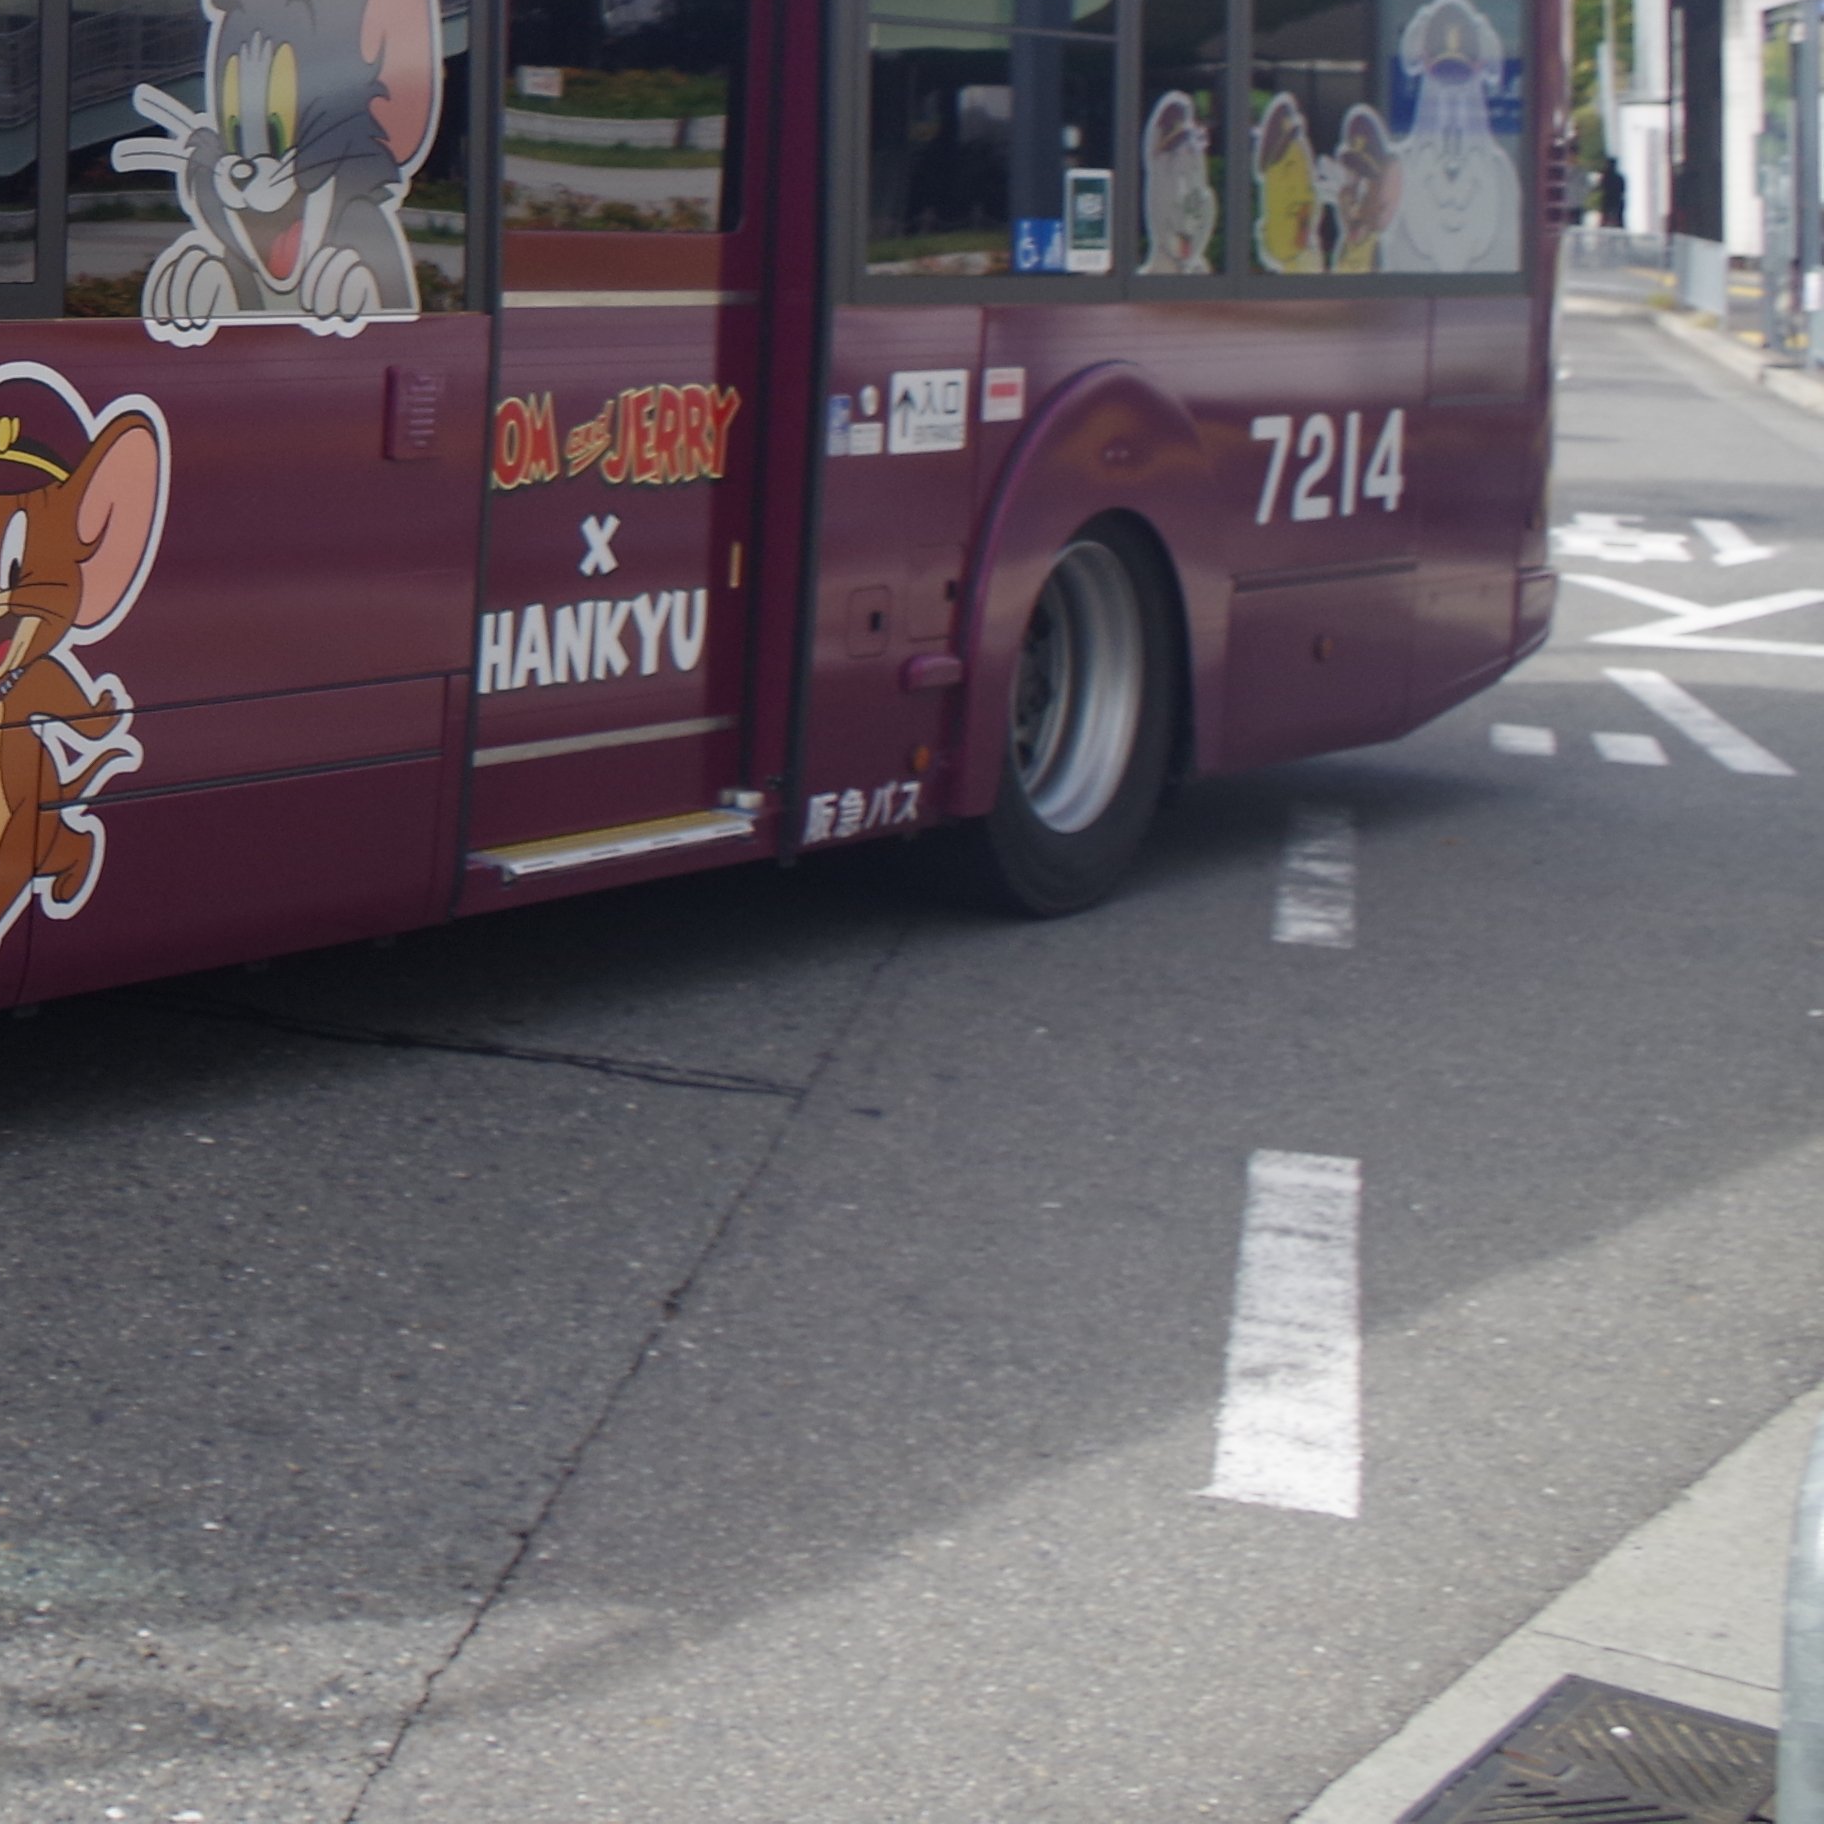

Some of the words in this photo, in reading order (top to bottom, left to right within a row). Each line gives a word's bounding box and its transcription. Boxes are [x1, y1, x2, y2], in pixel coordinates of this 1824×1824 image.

[600, 382, 743, 486] JERRY
[918, 379, 962, 416] 入口
[1249, 408, 1407, 528] 7214
[477, 587, 708, 696] HANKYU
[802, 780, 923, 845] 阪急バス
